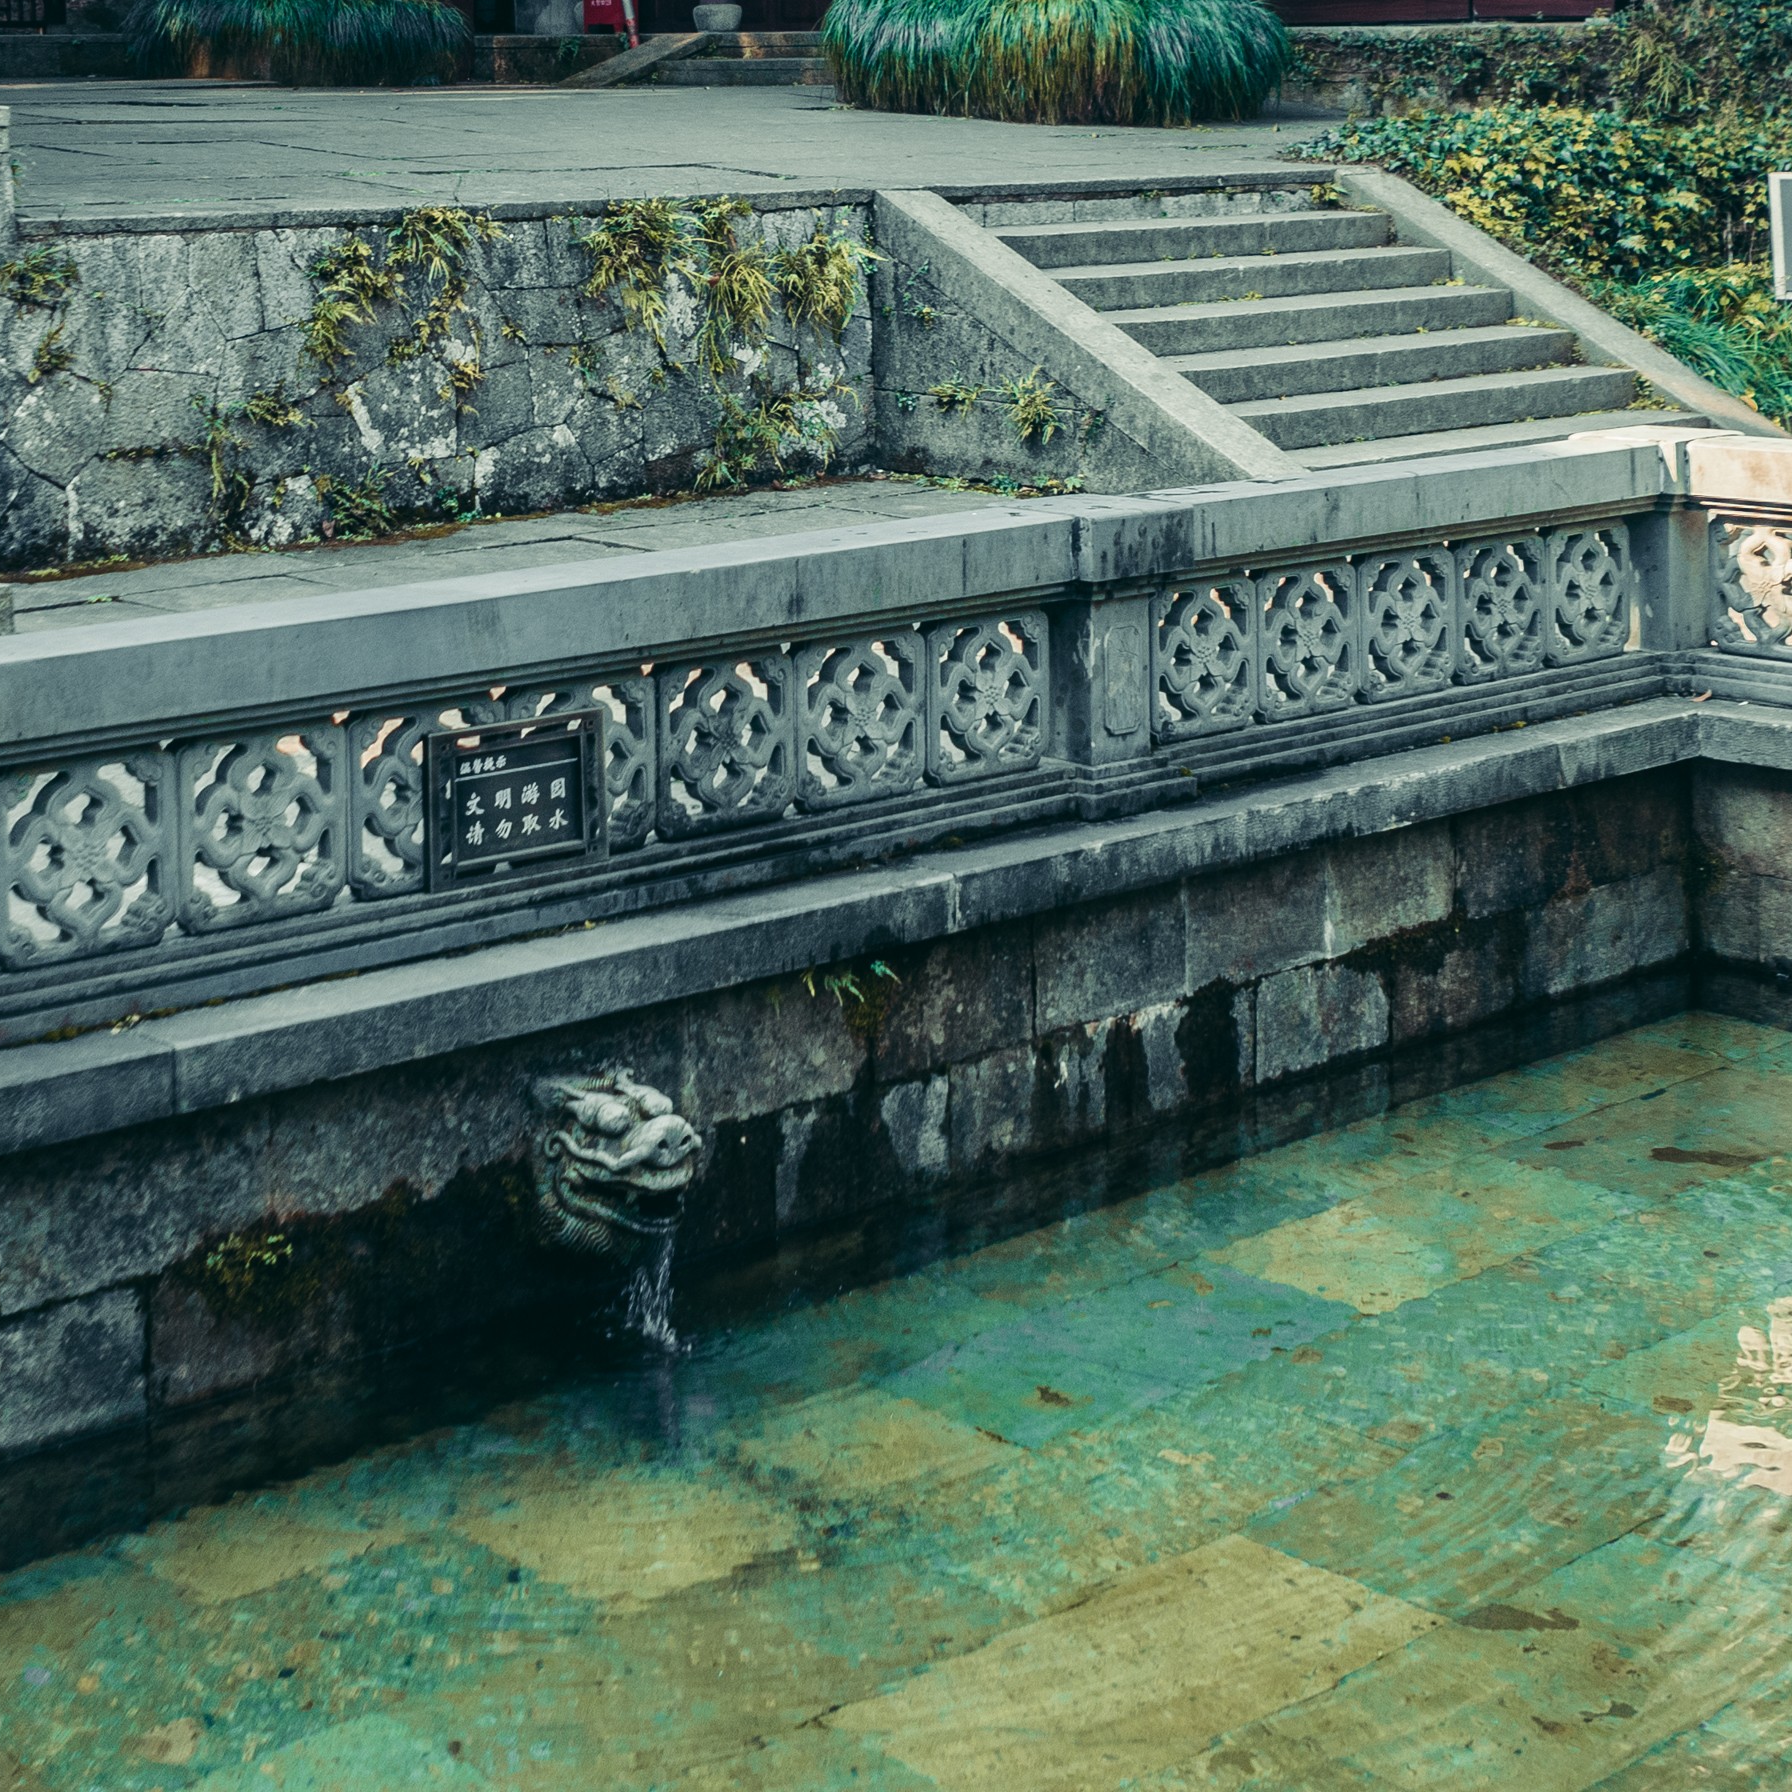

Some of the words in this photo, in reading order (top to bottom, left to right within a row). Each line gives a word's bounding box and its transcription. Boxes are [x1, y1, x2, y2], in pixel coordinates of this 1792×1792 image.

[459, 754, 507, 775] 温馨提示
[465, 777, 566, 816] 文明游园
[465, 808, 569, 846] 请勿取水
